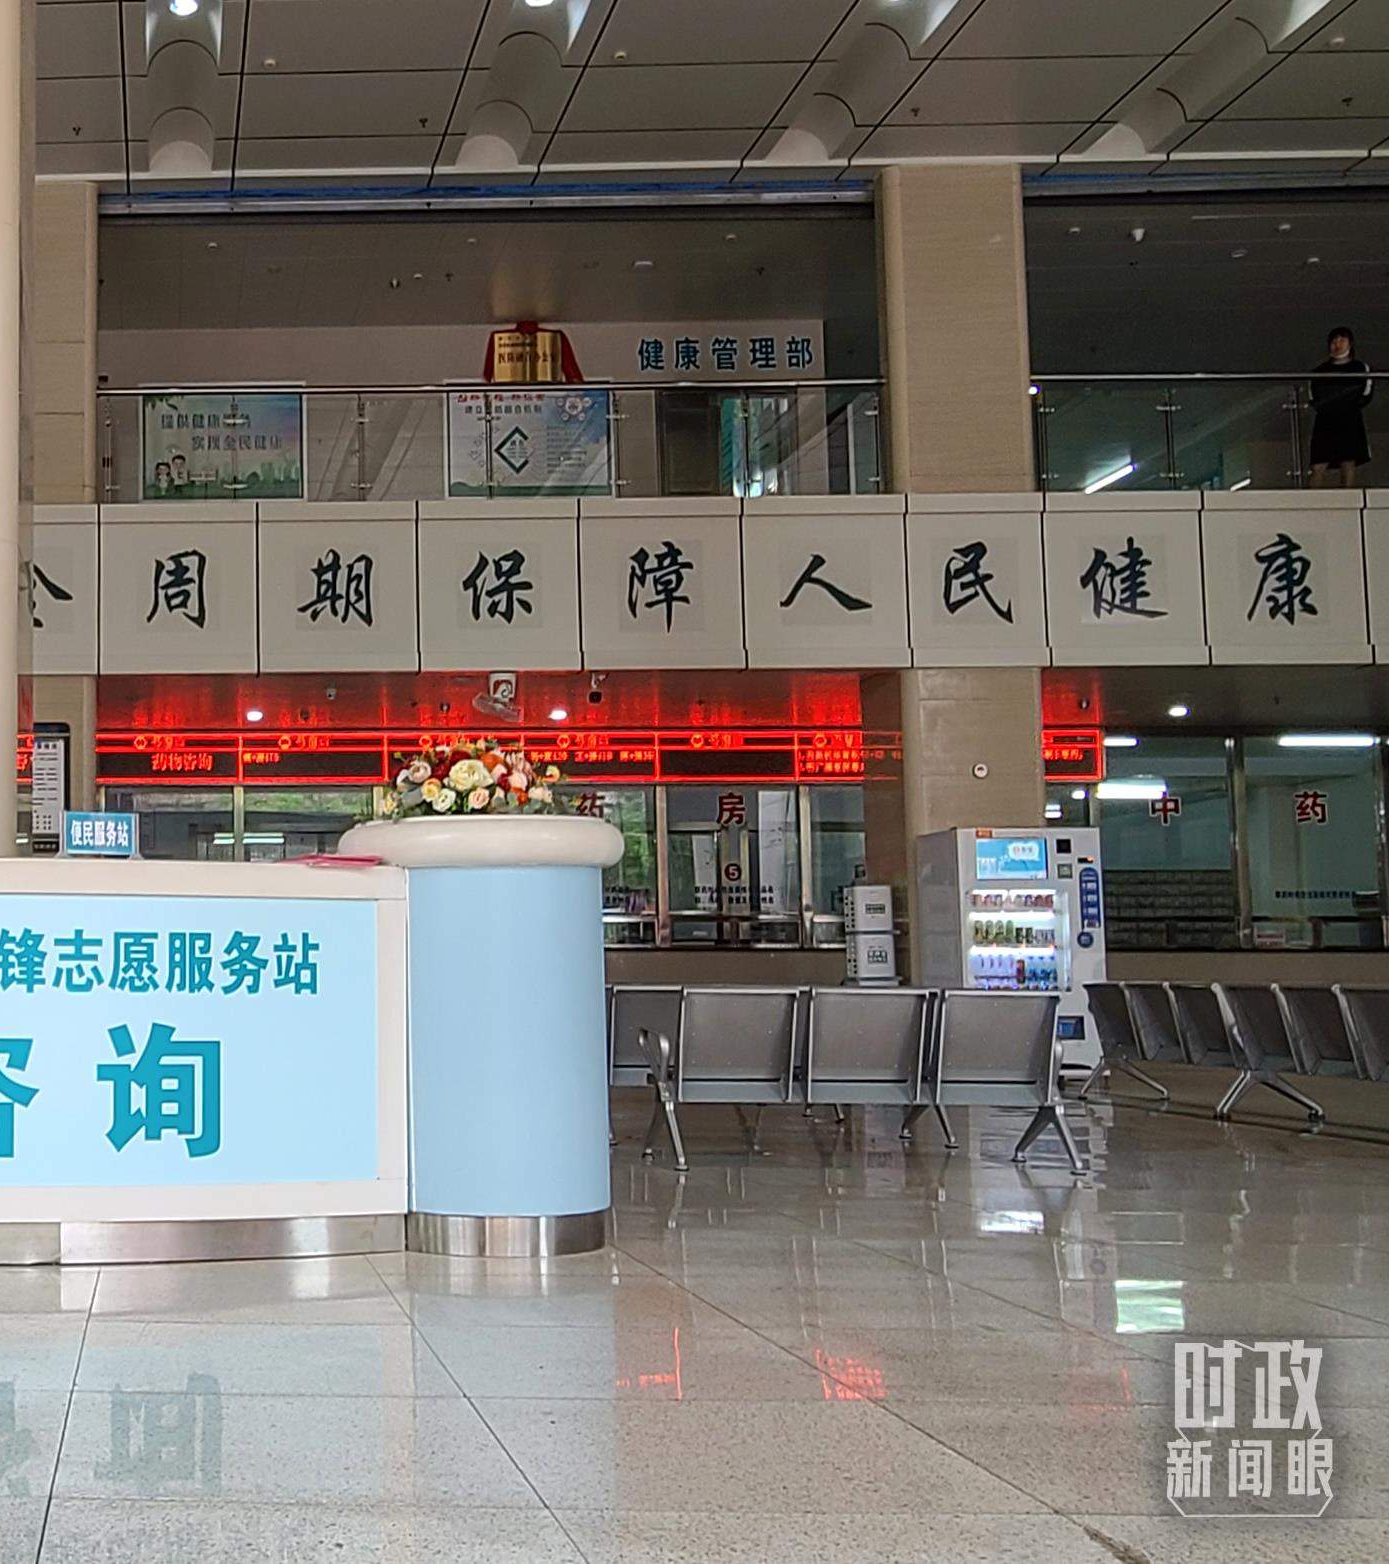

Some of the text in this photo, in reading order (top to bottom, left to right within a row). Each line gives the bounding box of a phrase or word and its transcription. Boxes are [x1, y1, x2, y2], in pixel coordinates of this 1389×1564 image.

[638, 337, 812, 370] 健康管理部
[71, 819, 129, 847] 便民服务站
[725, 863, 742, 882] 5
